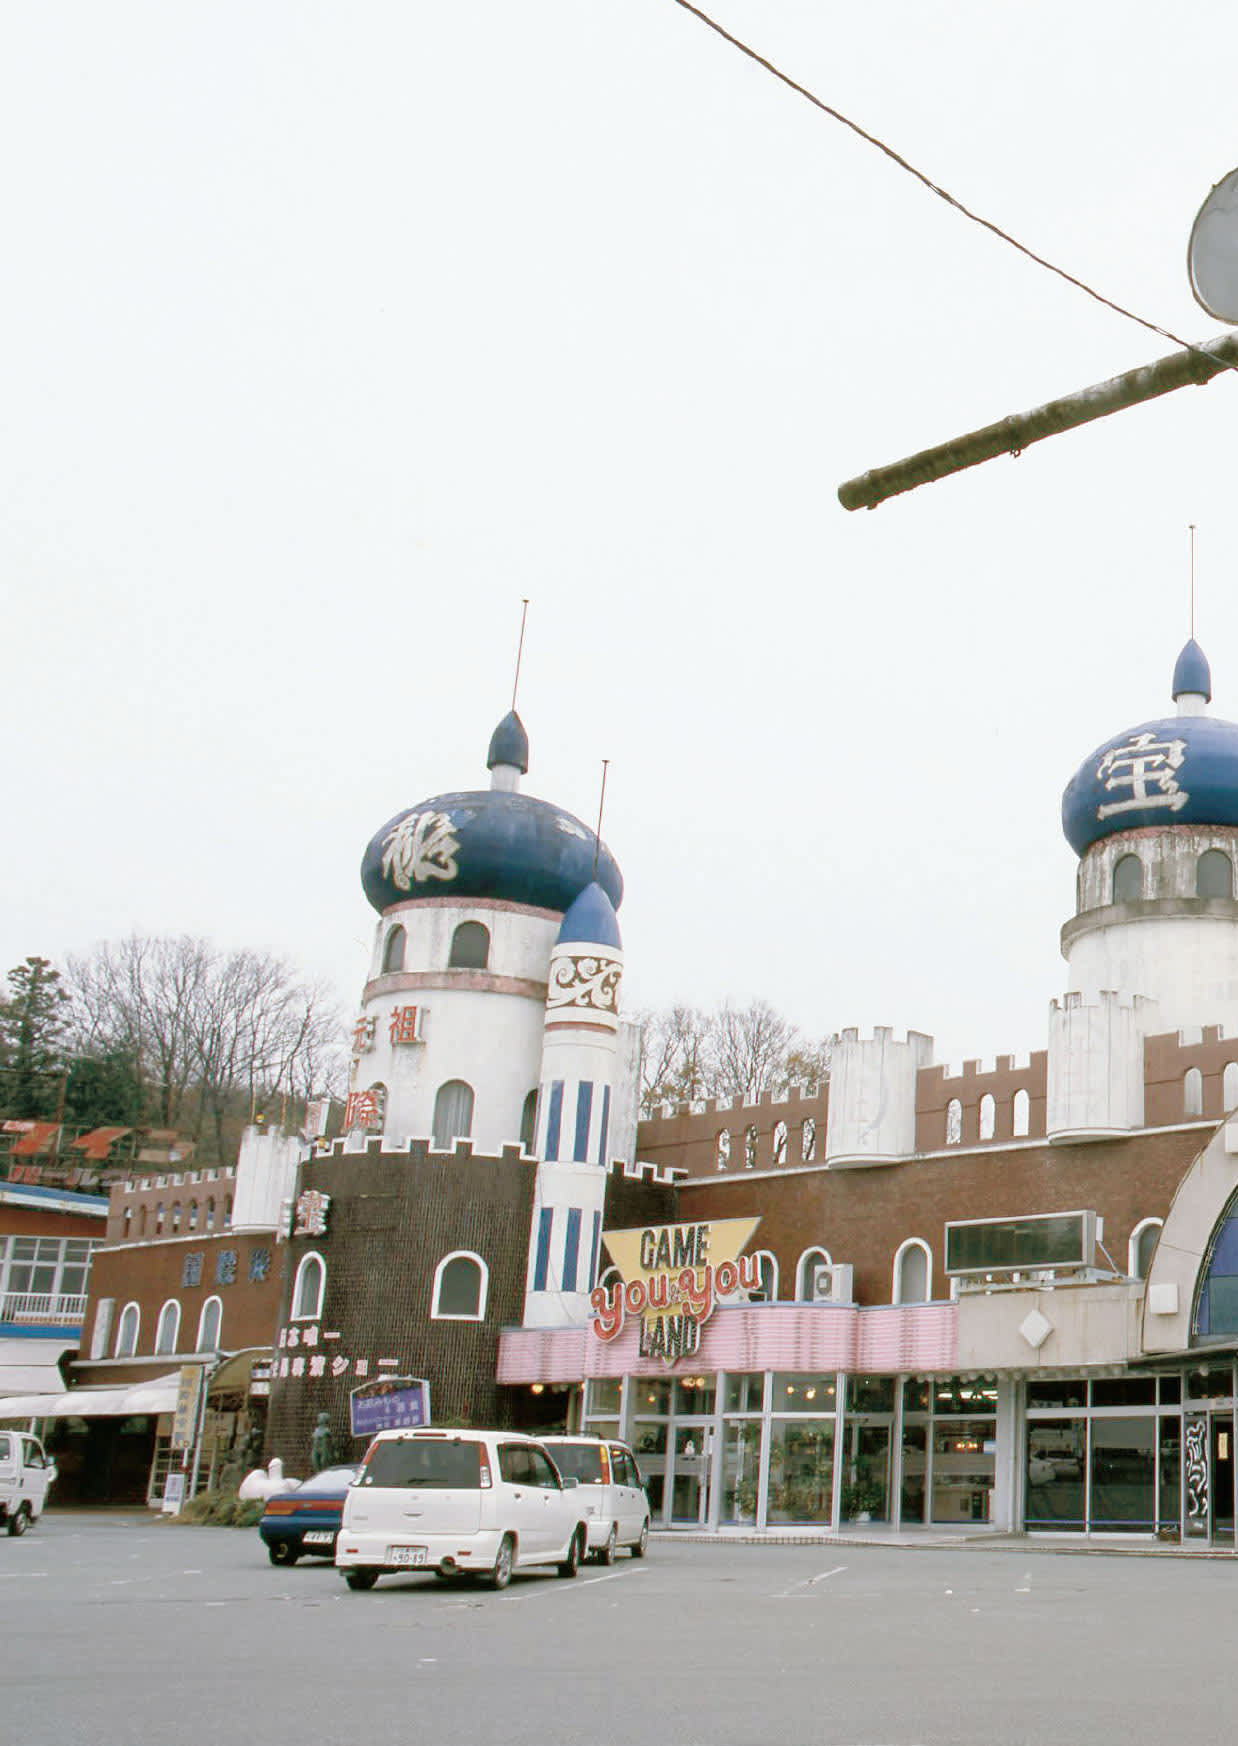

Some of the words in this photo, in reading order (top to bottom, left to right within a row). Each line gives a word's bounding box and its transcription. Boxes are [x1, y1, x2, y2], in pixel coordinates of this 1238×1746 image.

[1097, 733, 1189, 820] 宝
[640, 1215, 712, 1270] GAME
[639, 1315, 703, 1359] LAND
